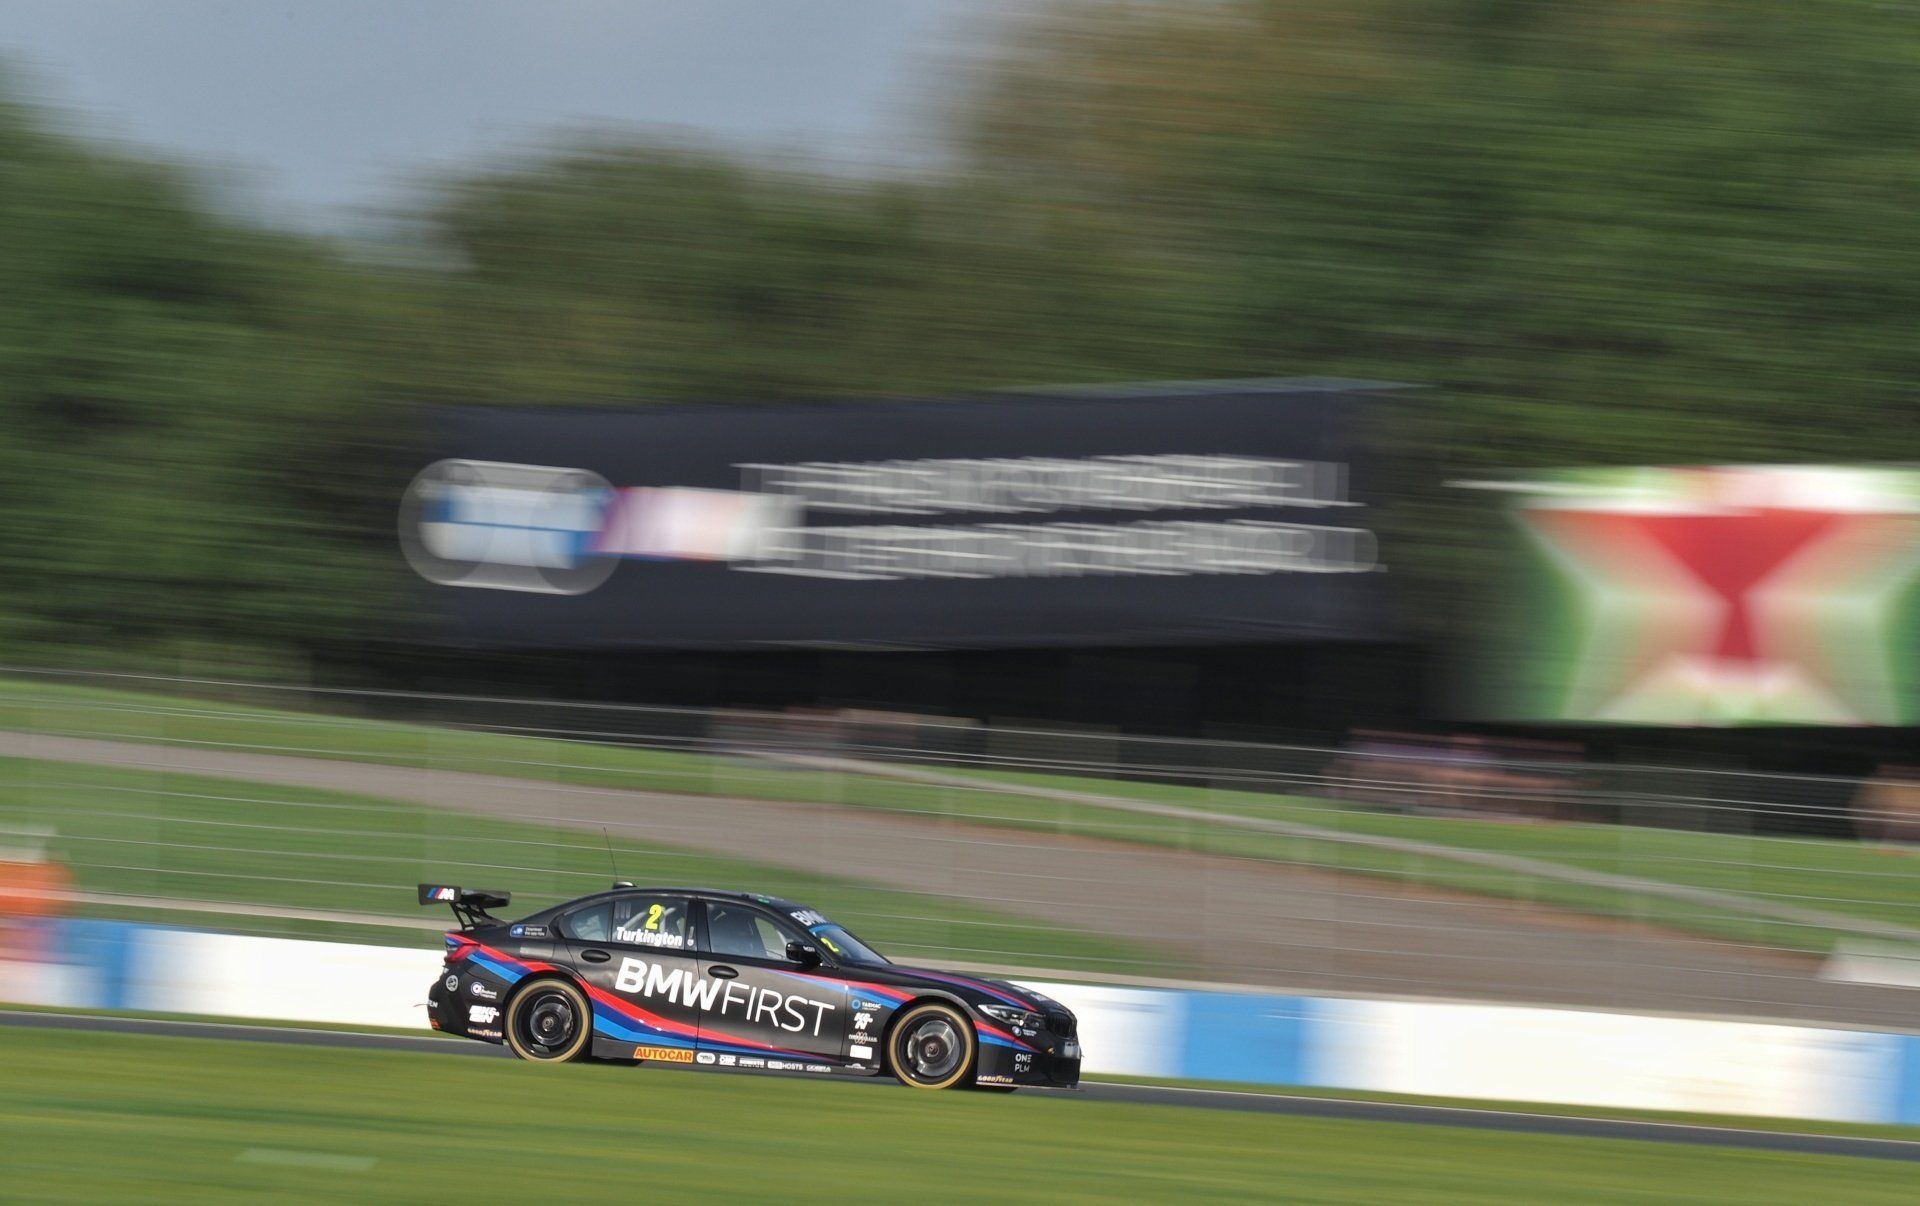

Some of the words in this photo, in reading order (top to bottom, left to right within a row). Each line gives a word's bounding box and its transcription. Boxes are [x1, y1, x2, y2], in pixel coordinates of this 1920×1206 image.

[646, 904, 662, 930] 2
[617, 927, 683, 946] Turkington
[634, 1048, 693, 1062] AUTOCAR
[1015, 1053, 1032, 1063] ONE
[1014, 1063, 1030, 1072] PLM
